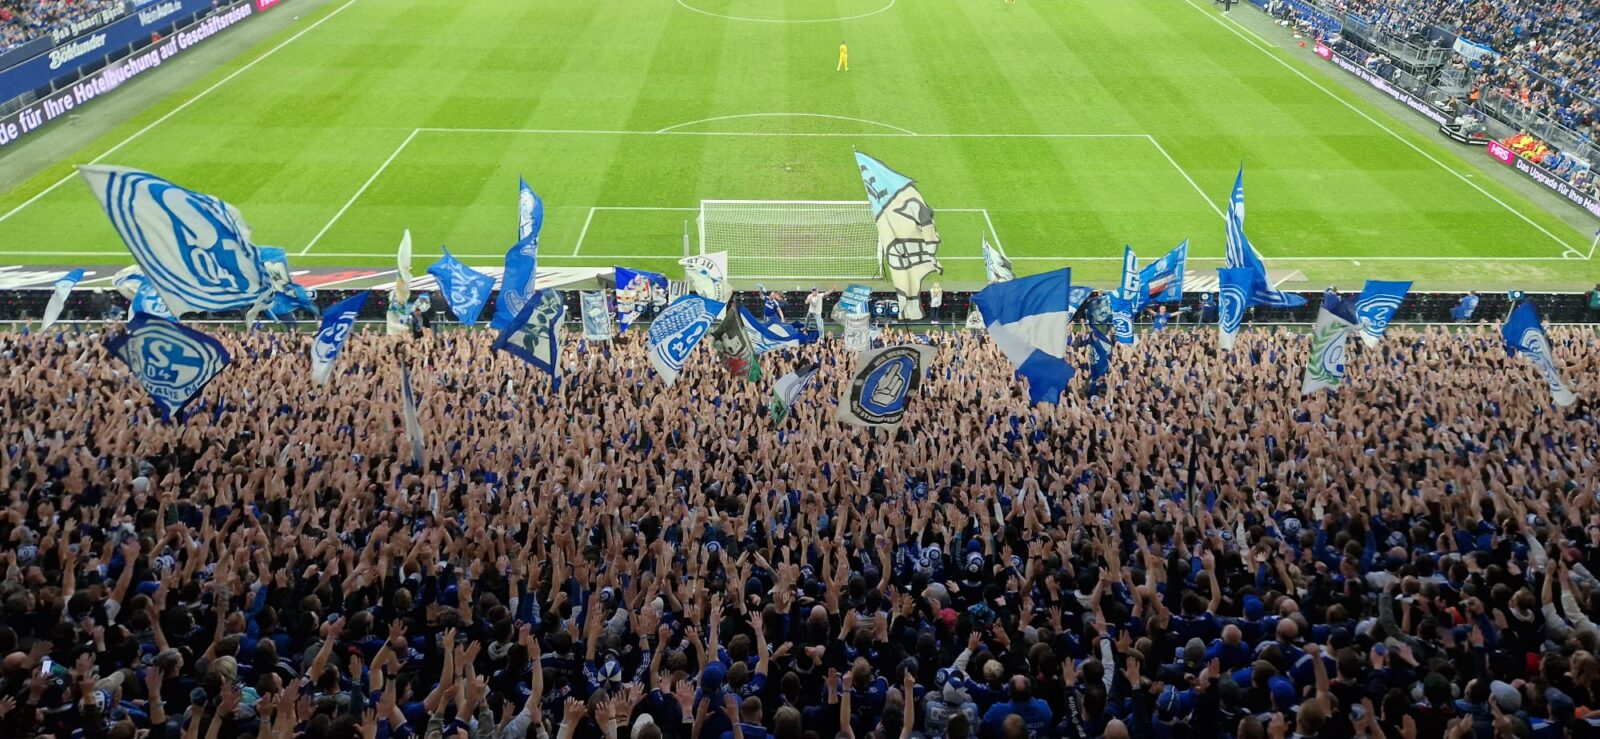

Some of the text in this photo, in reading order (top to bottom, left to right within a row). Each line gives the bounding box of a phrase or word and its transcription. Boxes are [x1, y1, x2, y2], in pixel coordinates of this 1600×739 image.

[19, 108, 42, 132] für
[43, 94, 74, 120] Ihre
[73, 49, 160, 105] Hotelbuchung
[160, 35, 178, 60] auf
[178, 3, 252, 49] Geschäftsreisen
[1490, 143, 1511, 161] HRS
[1516, 159, 1529, 173] Das
[1530, 168, 1558, 189] Upgrade
[1558, 184, 1570, 196] für
[1568, 191, 1583, 205] Ihre
